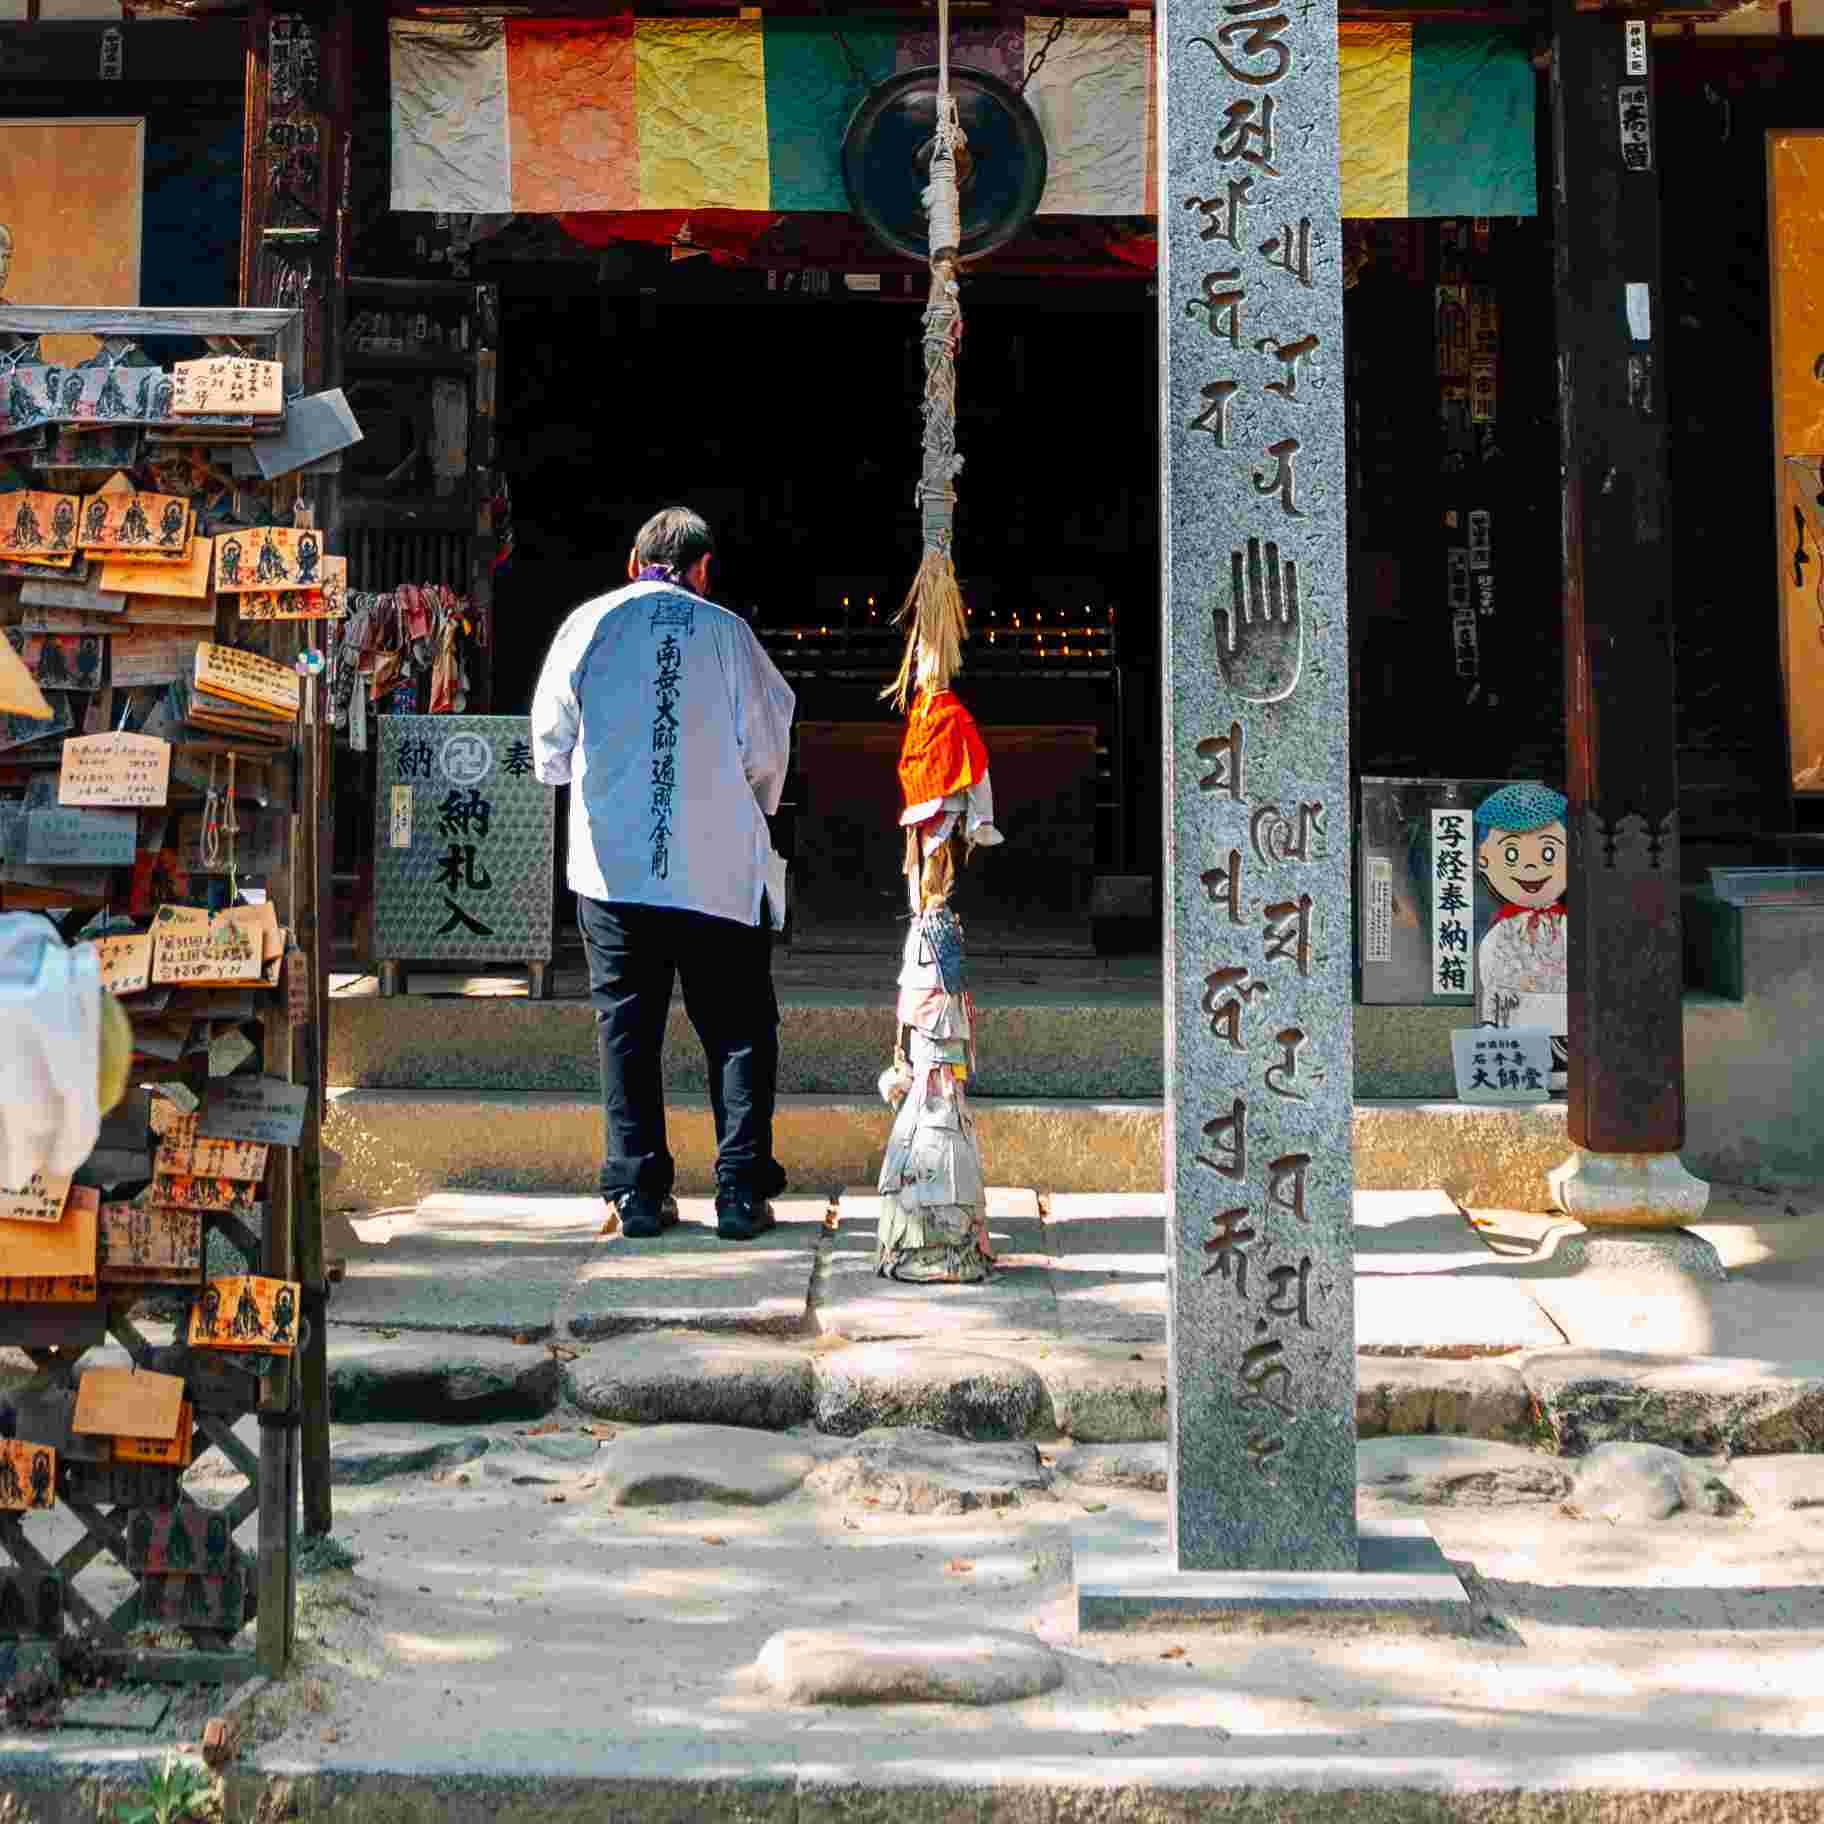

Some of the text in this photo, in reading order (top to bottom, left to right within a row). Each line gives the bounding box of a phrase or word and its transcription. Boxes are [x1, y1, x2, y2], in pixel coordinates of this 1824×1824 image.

[434, 787, 495, 941] 納札入
[1435, 814, 1469, 992] 写経奉納箱
[1469, 1066, 1544, 1090] 大師堂
